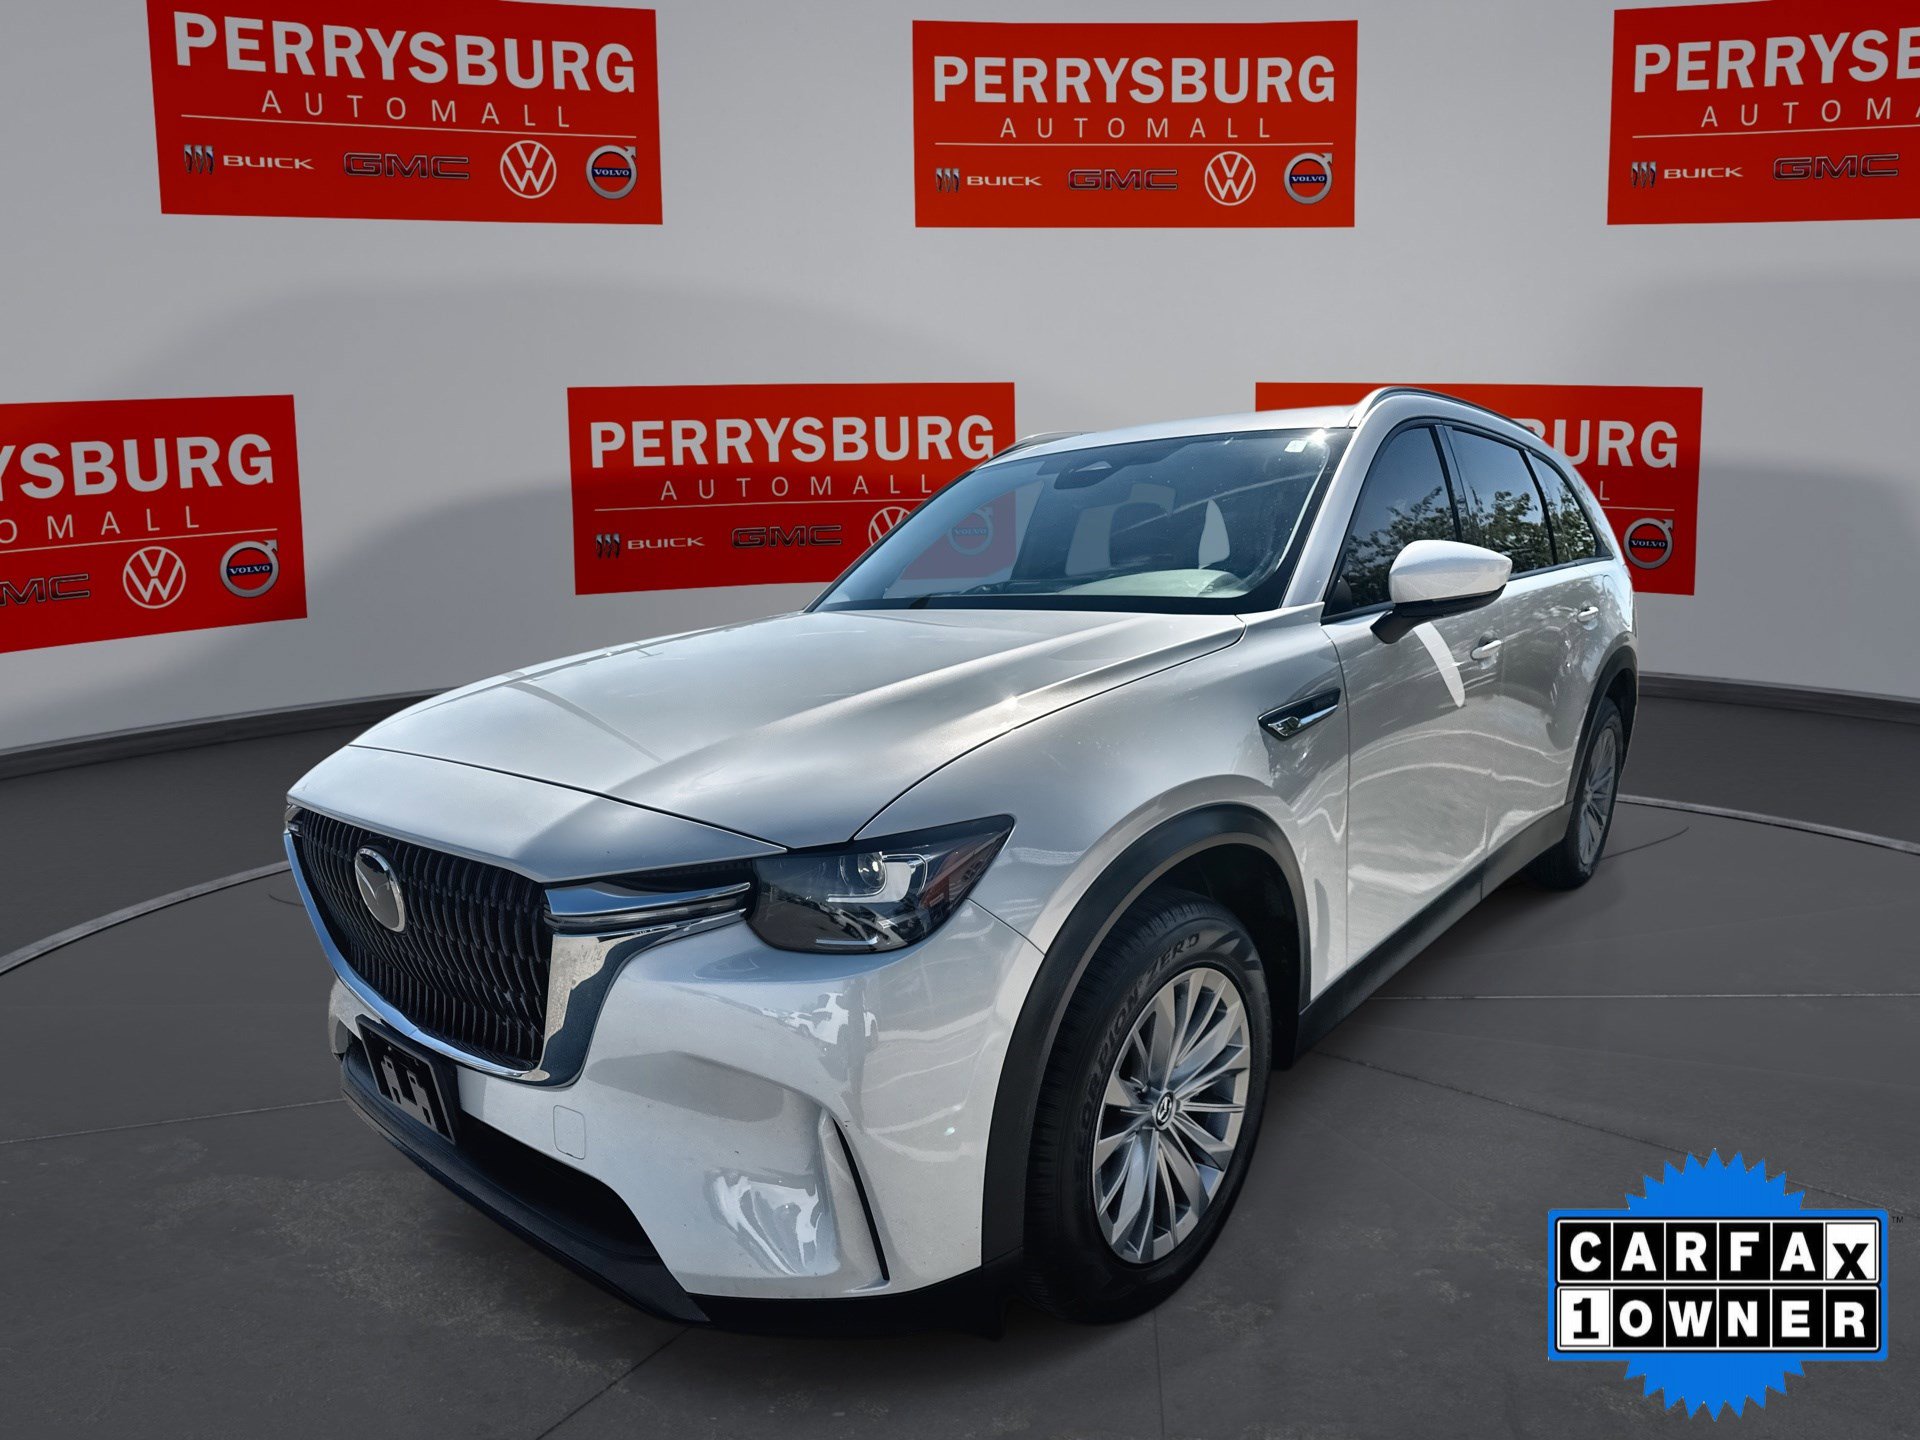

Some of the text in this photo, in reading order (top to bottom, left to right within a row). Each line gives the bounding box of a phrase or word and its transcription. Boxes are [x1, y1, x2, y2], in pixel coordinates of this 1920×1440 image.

[174, 11, 635, 93] PERRYSBURG
[934, 55, 1335, 104] PERRYSBURG
[261, 90, 570, 129] AUTOMALL
[1701, 97, 1920, 128] AUTOM
[1000, 117, 1270, 138] AUTOMALL
[223, 155, 315, 169] BUICK
[343, 152, 470, 180] GMC
[594, 168, 629, 178] VOLVO
[967, 176, 1042, 186] BUICK
[1067, 168, 1178, 191] GMC
[1291, 174, 1326, 183] VOLVO
[1664, 153, 1899, 180] BUICK GMC
[590, 415, 994, 468] PERRYSBURG
[661, 474, 932, 500] AUTOMALL
[628, 536, 704, 550] BUICK
[731, 524, 842, 547] GMC
[1630, 540, 1667, 548] VOLVO
[229, 564, 270, 574] VOLVO
